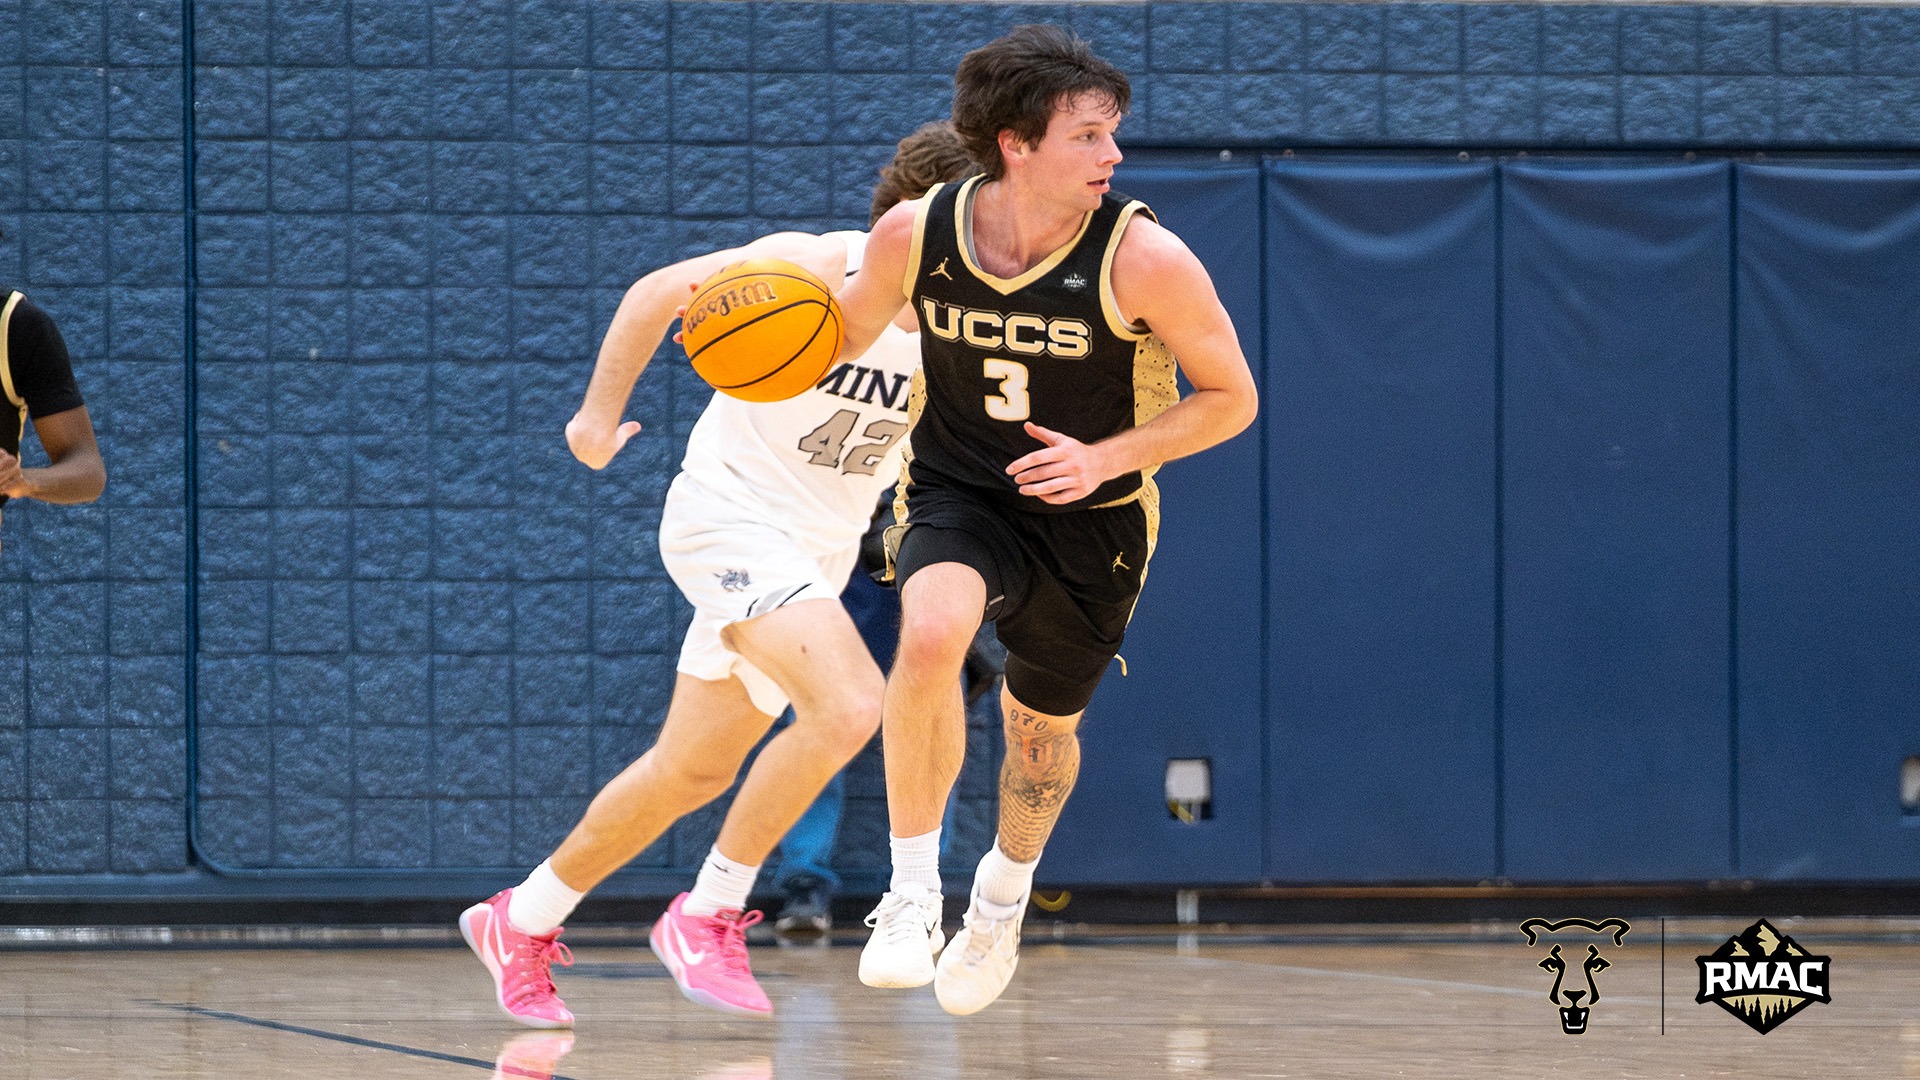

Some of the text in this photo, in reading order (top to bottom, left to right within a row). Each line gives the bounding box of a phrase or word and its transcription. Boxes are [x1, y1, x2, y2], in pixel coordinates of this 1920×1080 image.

[686, 281, 778, 335] Wilson
[1064, 278, 1086, 286] RMAC
[921, 296, 1092, 360] UCCS
[816, 362, 912, 412] MIN
[983, 358, 1031, 422] 3
[798, 408, 909, 476] 42
